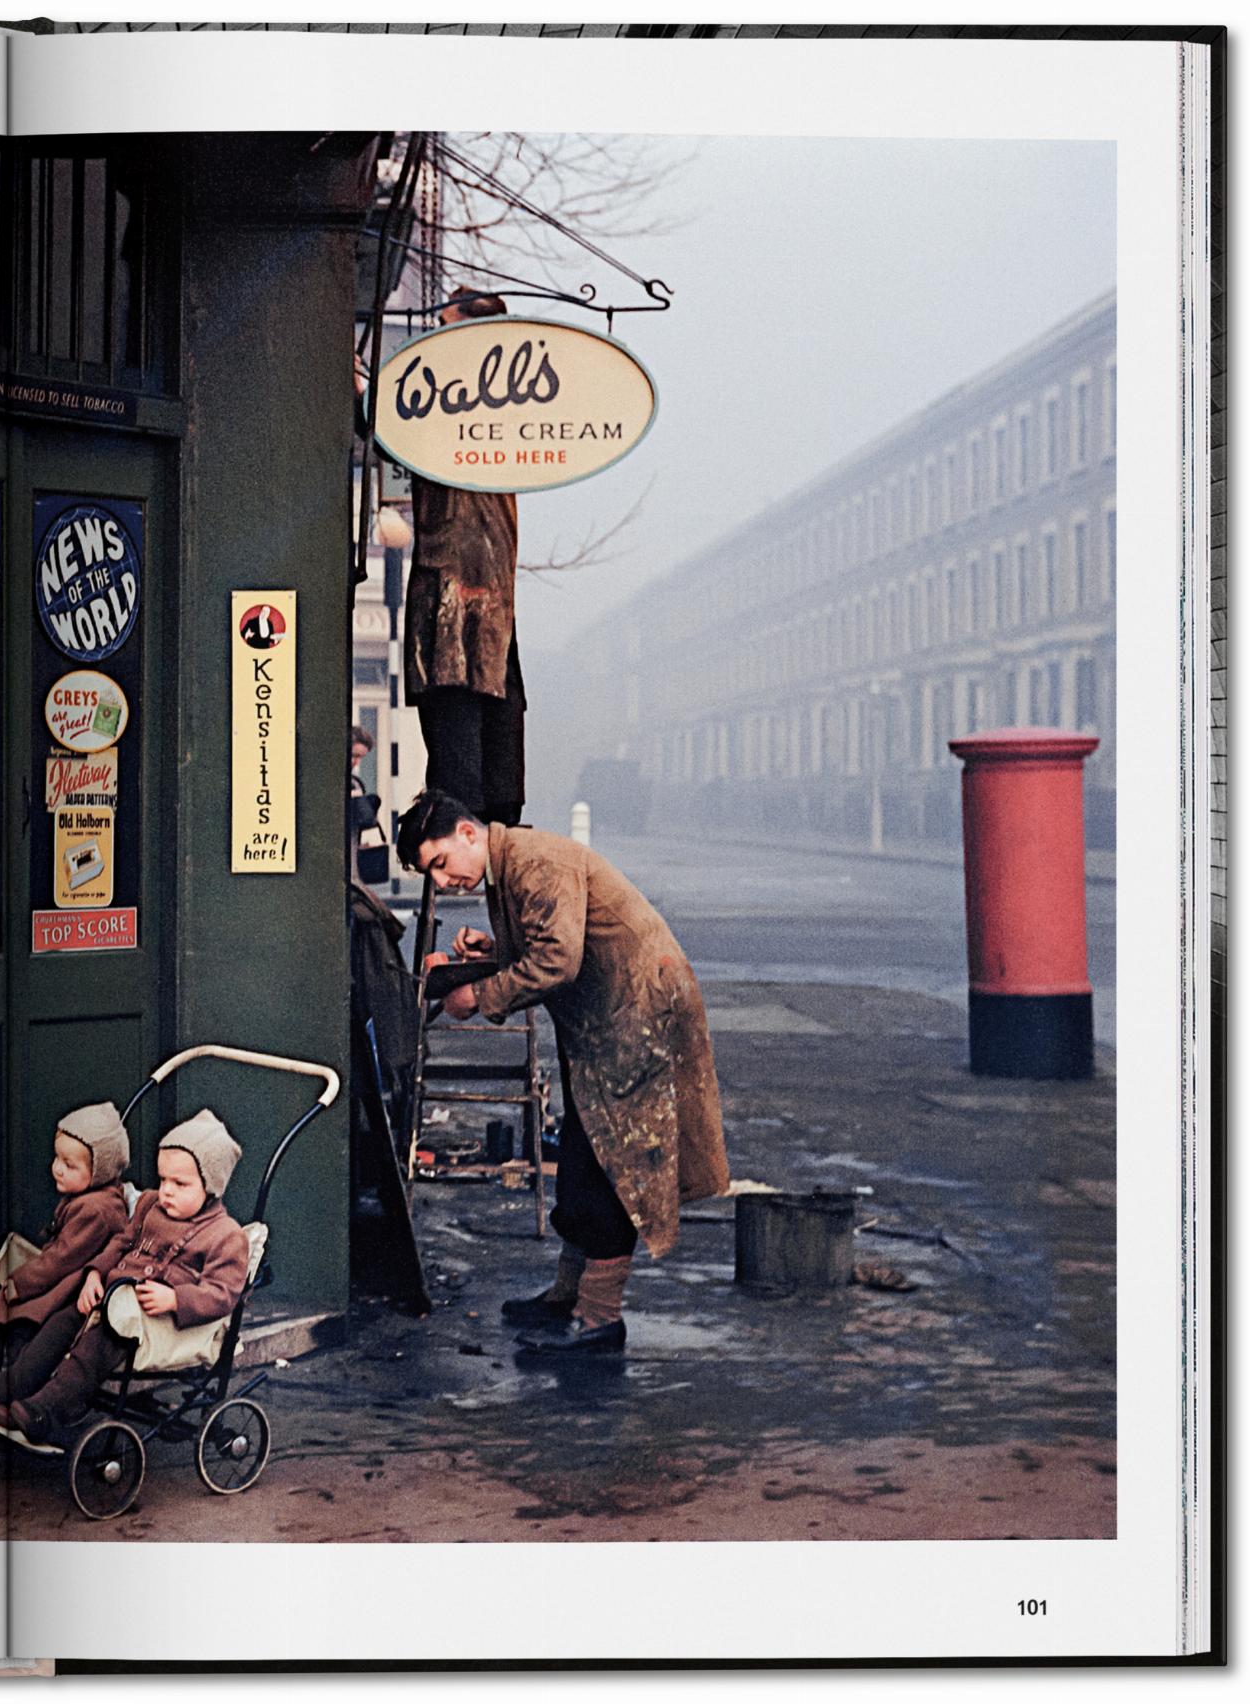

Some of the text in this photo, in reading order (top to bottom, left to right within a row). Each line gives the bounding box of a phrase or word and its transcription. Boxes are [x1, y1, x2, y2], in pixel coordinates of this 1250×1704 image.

[61, 393, 80, 408] SELL
[459, 422, 622, 440] ICE CREAM
[454, 451, 566, 465] SOLD HERE
[41, 518, 125, 605] NEWS
[68, 567, 111, 604] OF THE
[50, 572, 137, 651] WORLD
[53, 689, 99, 707] GREYS
[52, 711, 68, 723] are
[59, 710, 93, 738] great!
[252, 658, 274, 824] Kensitas
[75, 813, 110, 829] Holborn
[253, 832, 279, 845] are
[243, 837, 287, 861] here!
[42, 914, 128, 945] TOP SCORE
[1017, 1599, 1047, 1616] 101
